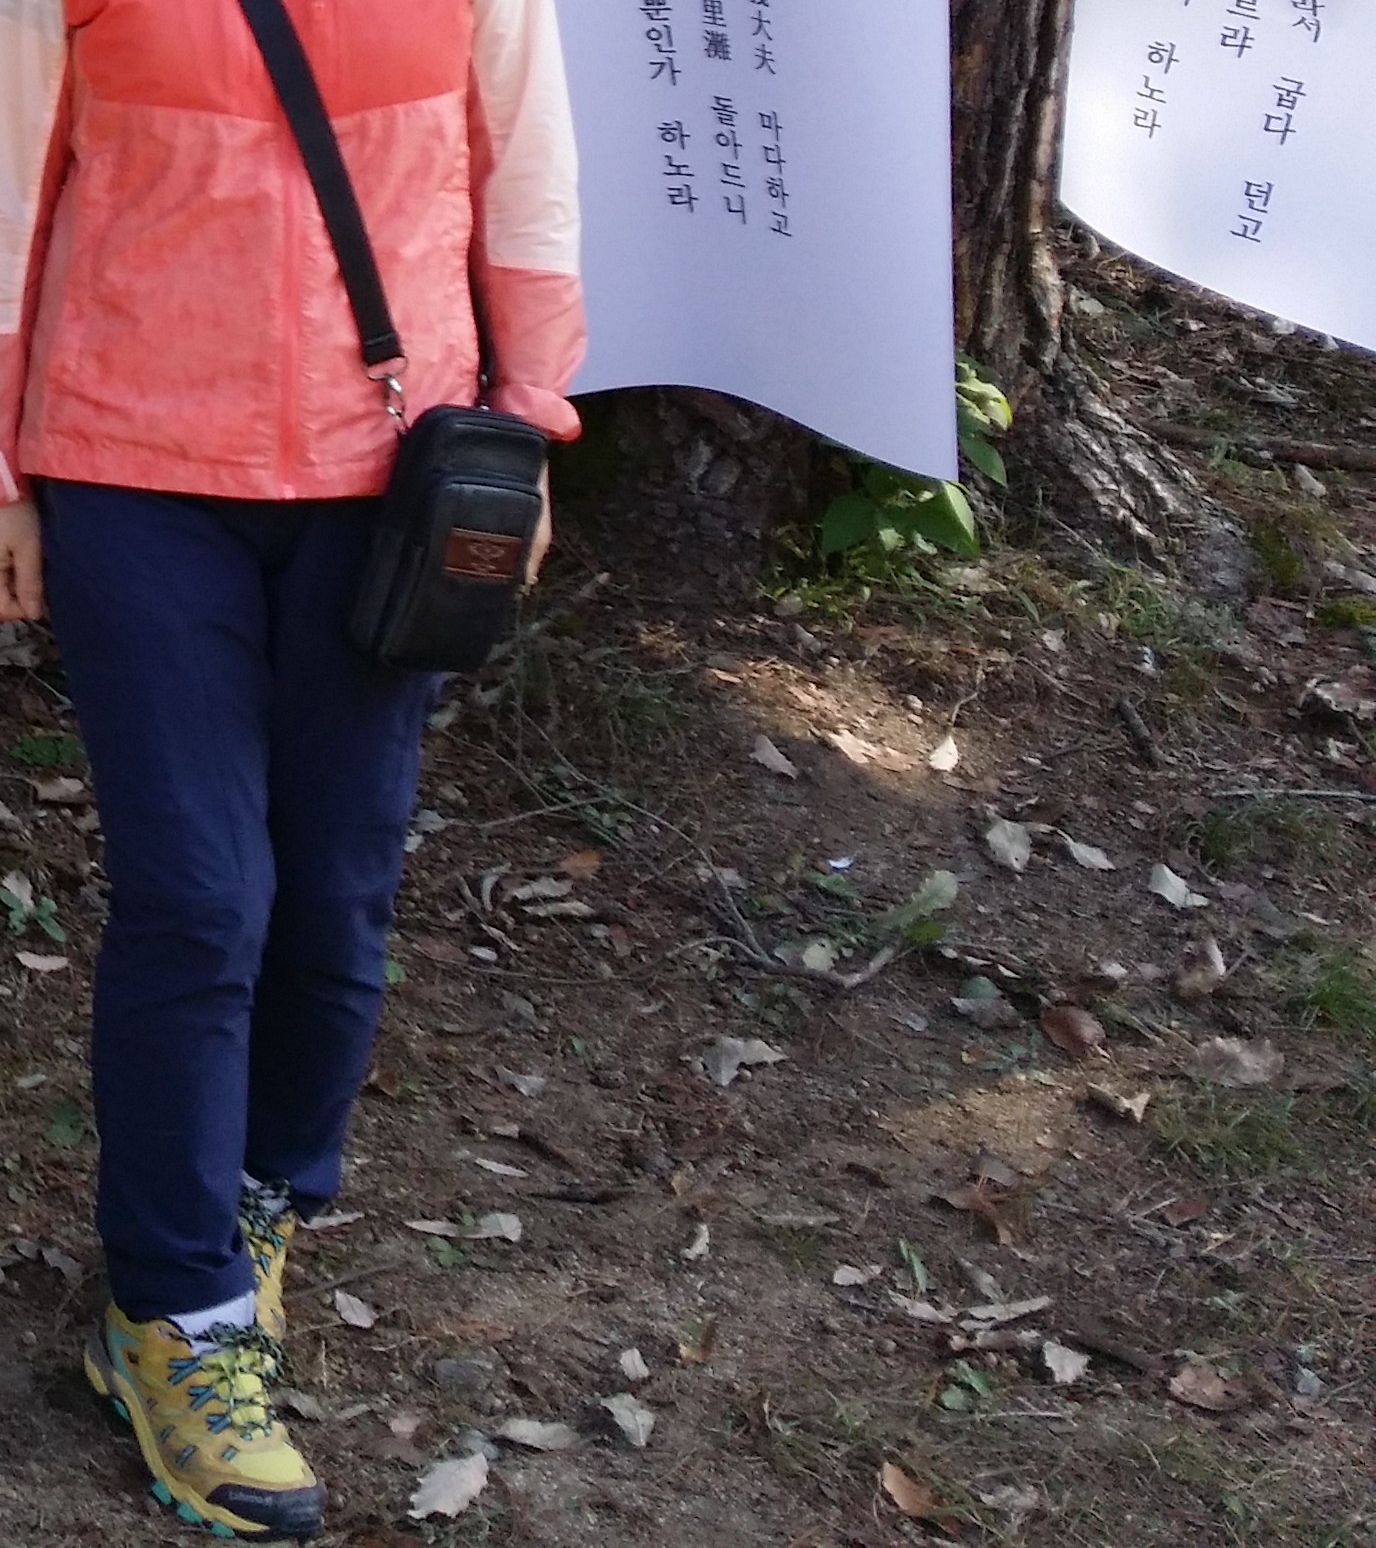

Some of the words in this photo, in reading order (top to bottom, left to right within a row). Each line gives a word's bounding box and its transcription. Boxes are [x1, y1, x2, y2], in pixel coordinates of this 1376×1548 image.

[1133, 41, 1180, 139] 하노라
[1263, 77, 1307, 145] 굽다
[657, 120, 699, 214] 하노라
[711, 95, 747, 225] 돌아드니
[758, 111, 792, 237] 마다하고
[1230, 180, 1274, 243] 던고
